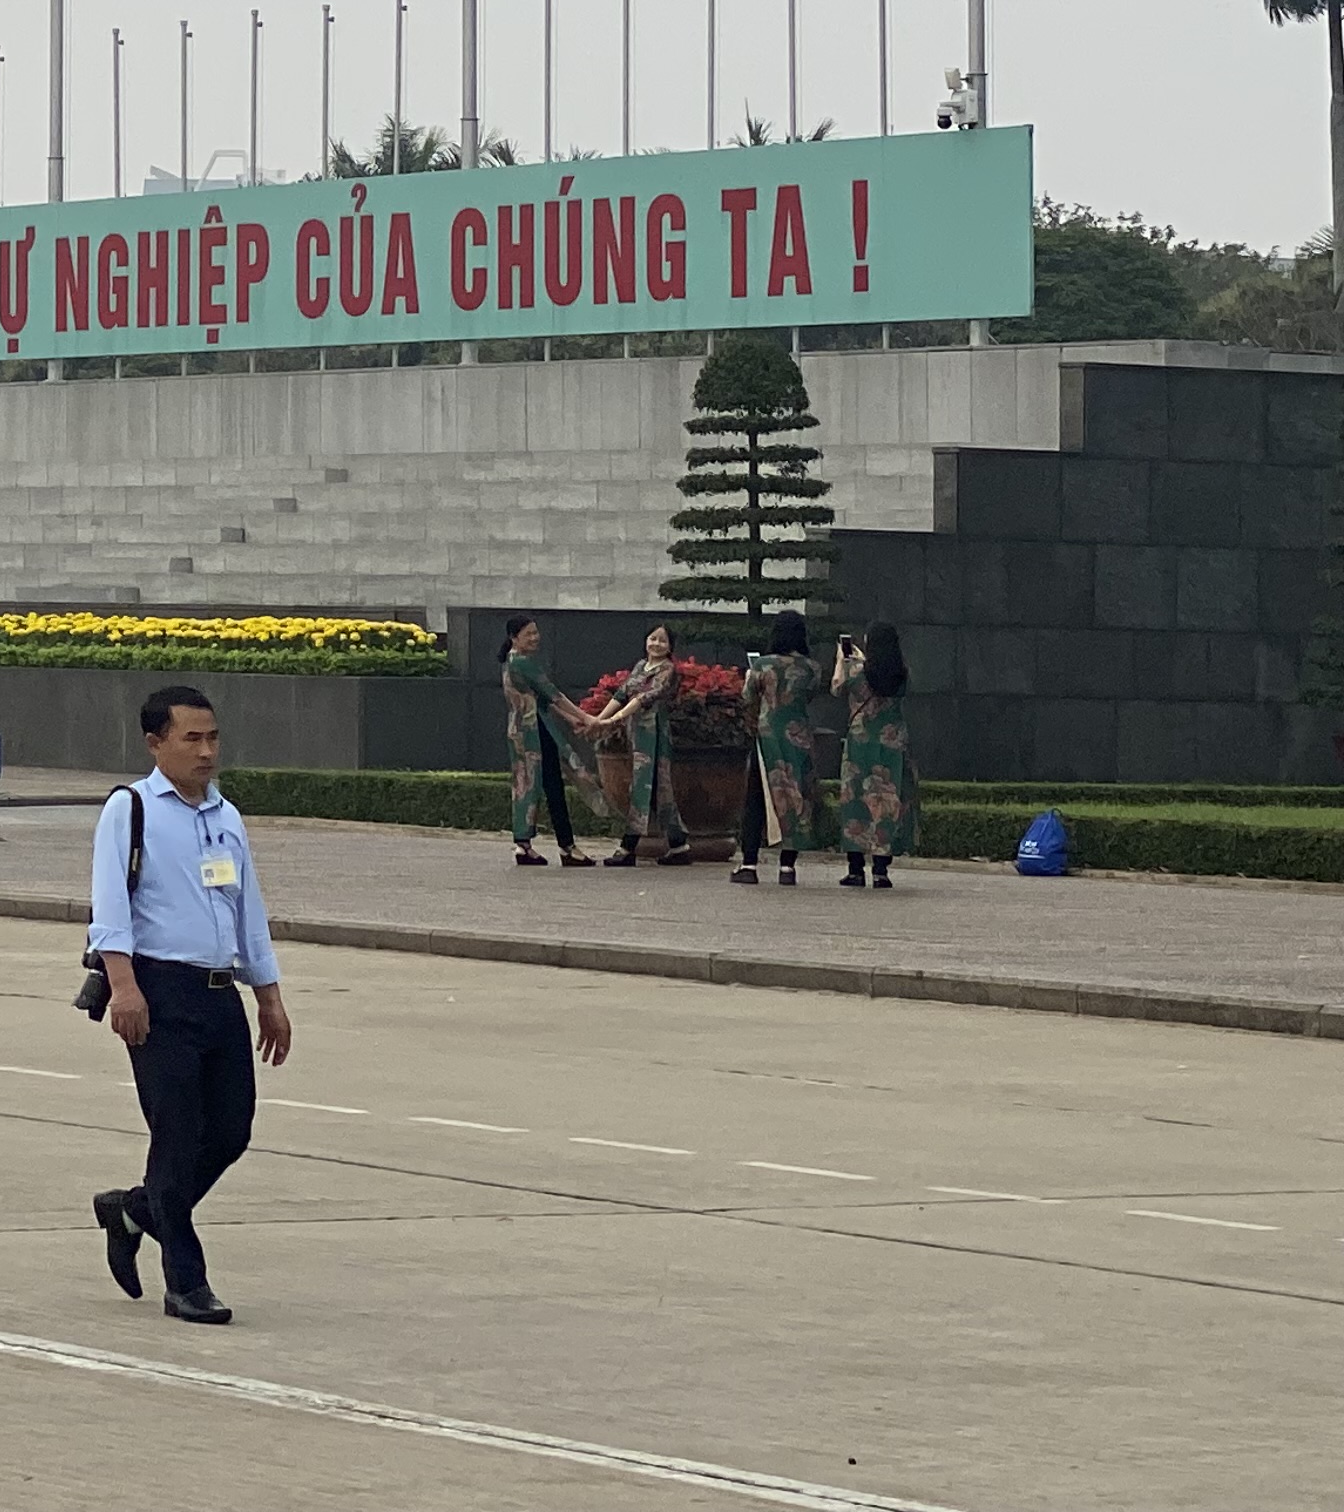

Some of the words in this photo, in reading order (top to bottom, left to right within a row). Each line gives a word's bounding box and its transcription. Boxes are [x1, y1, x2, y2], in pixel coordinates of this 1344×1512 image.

[54, 205, 271, 344] NGHIỆP
[295, 184, 420, 321] CỦA
[450, 176, 688, 312] CHÚNG
[721, 183, 813, 300] TA
[852, 179, 869, 292] !
